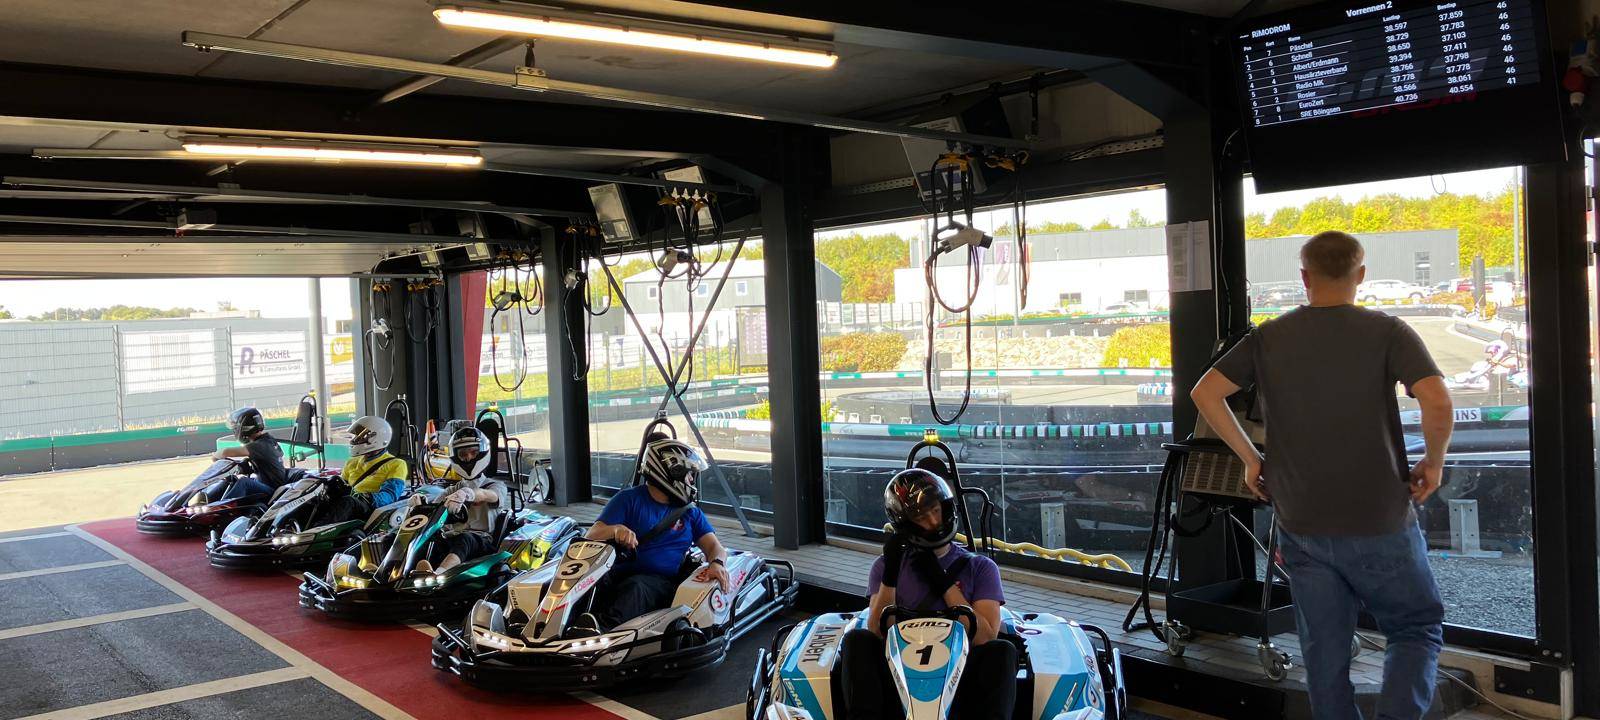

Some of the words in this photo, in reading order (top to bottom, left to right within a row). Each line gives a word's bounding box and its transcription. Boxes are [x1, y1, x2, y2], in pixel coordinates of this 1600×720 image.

[1346, 4, 1386, 17] Vorrennen
[1386, 1, 1392, 10] 2
[1252, 24, 1290, 38] RiMODROM
[1290, 42, 1313, 52] Päschel
[1384, 22, 1408, 32] 38.597
[1438, 10, 1463, 21] 37.859
[1291, 52, 1312, 62] Schnell
[1386, 32, 1409, 42] 38.729
[1440, 21, 1464, 32] 37.783
[1498, 12, 1508, 20] 46
[1293, 57, 1339, 71] Albert/Erdmann
[1388, 42, 1410, 52] 38.650
[1442, 32, 1466, 42] 37.103
[1294, 65, 1348, 80] Hausärzteverband
[1389, 52, 1412, 63] 39.394
[1443, 42, 1467, 52] 37.411
[1296, 82, 1312, 90] Radio
[1313, 79, 1325, 87] MK
[1390, 63, 1414, 73] 38.766
[1444, 52, 1469, 63] 37.798
[1502, 44, 1513, 52] 46
[1392, 74, 1415, 83] 37.778
[1446, 64, 1470, 74] 37.778
[1504, 55, 1514, 63] 46
[1299, 99, 1324, 108] EuroZert
[1394, 83, 1416, 93] 38.566
[1448, 74, 1471, 84] 38.061
[1506, 66, 1516, 74] 46
[1300, 110, 1312, 118] SRE
[1395, 93, 1418, 102] 40.736
[1449, 84, 1474, 94] 40.554
[1507, 77, 1516, 85] 41
[260, 349, 290, 360] PÄSCHEL
[405, 517, 423, 528] 8
[561, 563, 583, 576] 3
[715, 596, 722, 608] 3
[802, 634, 836, 662] Albert
[916, 645, 933, 665] 1
